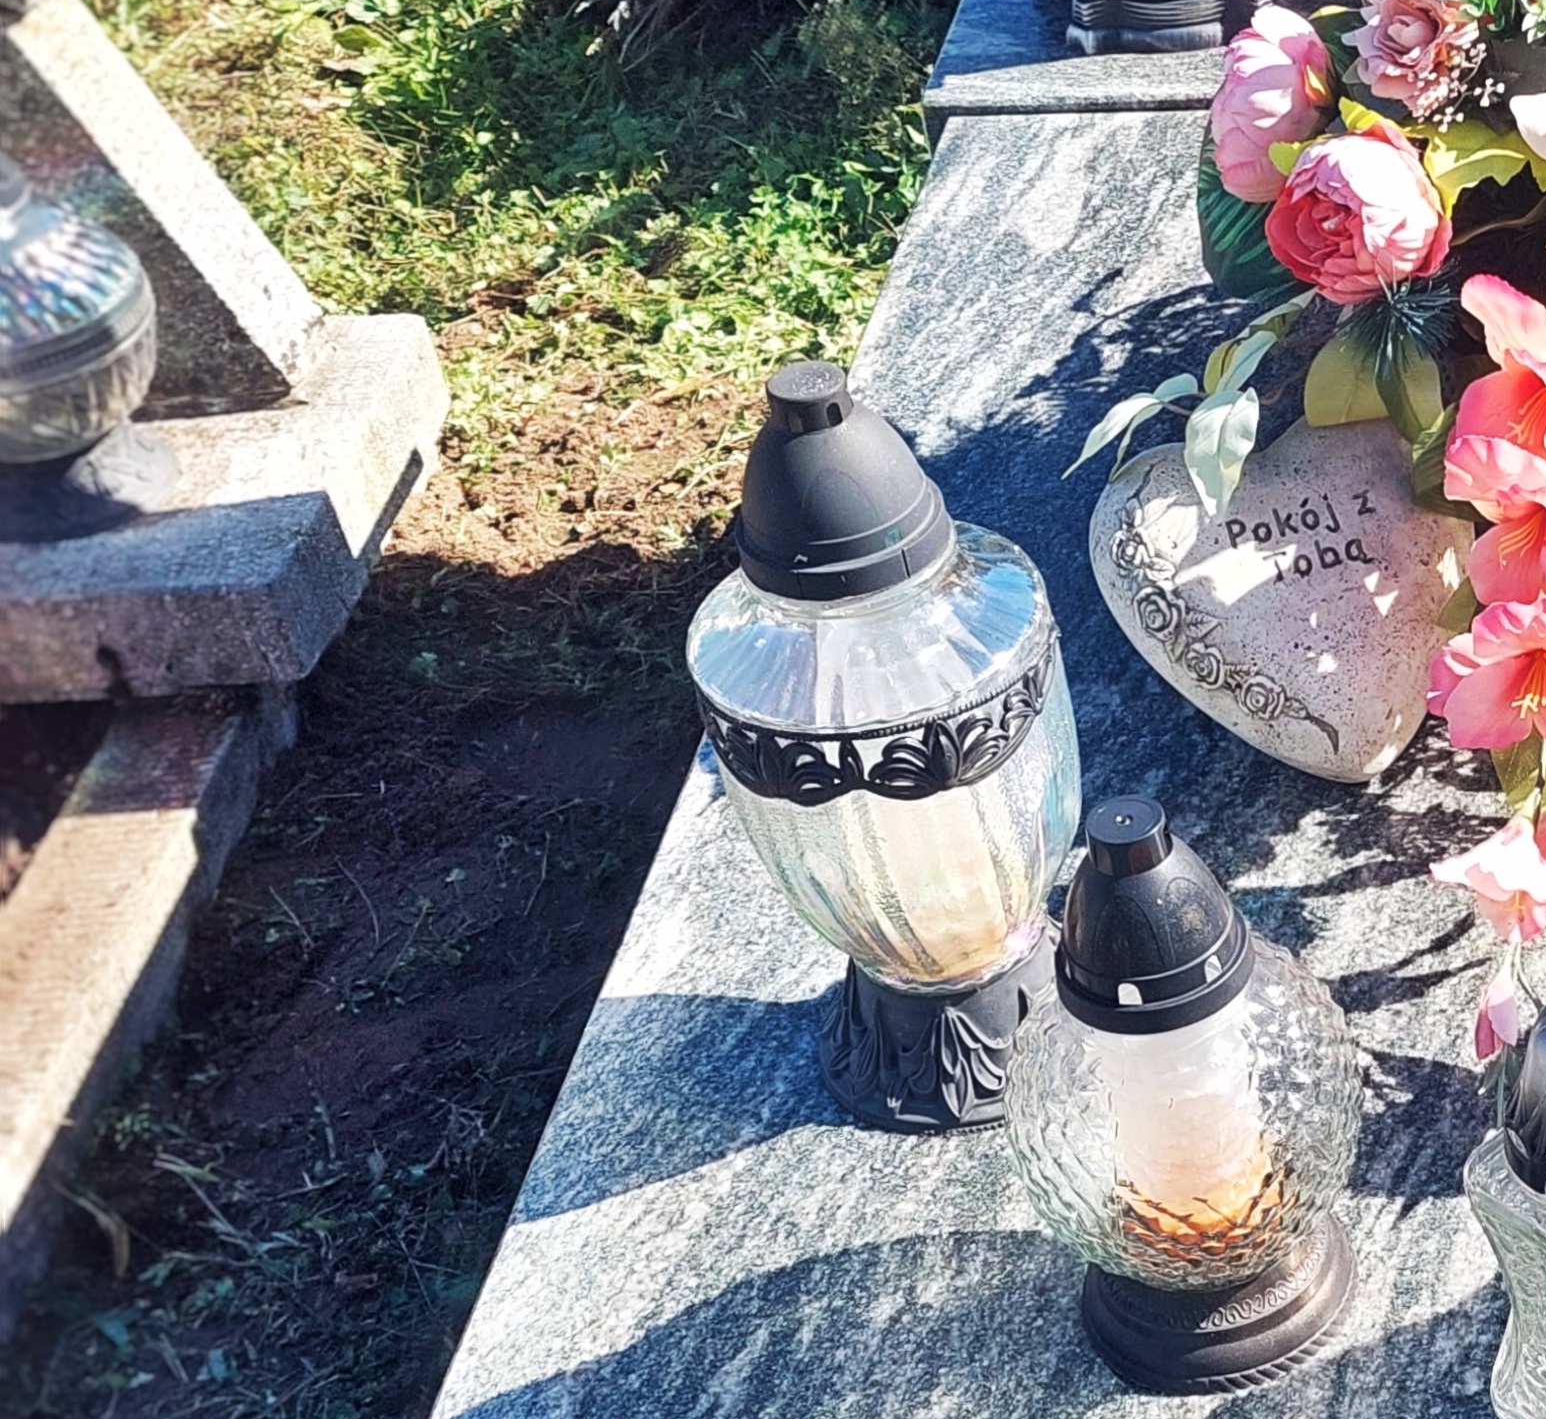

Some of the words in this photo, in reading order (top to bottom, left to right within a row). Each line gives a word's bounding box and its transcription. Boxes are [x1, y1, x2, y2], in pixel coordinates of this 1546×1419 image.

[1225, 492, 1341, 550] Pokój
[1351, 489, 1377, 517] z
[1262, 538, 1376, 585] Tobą
